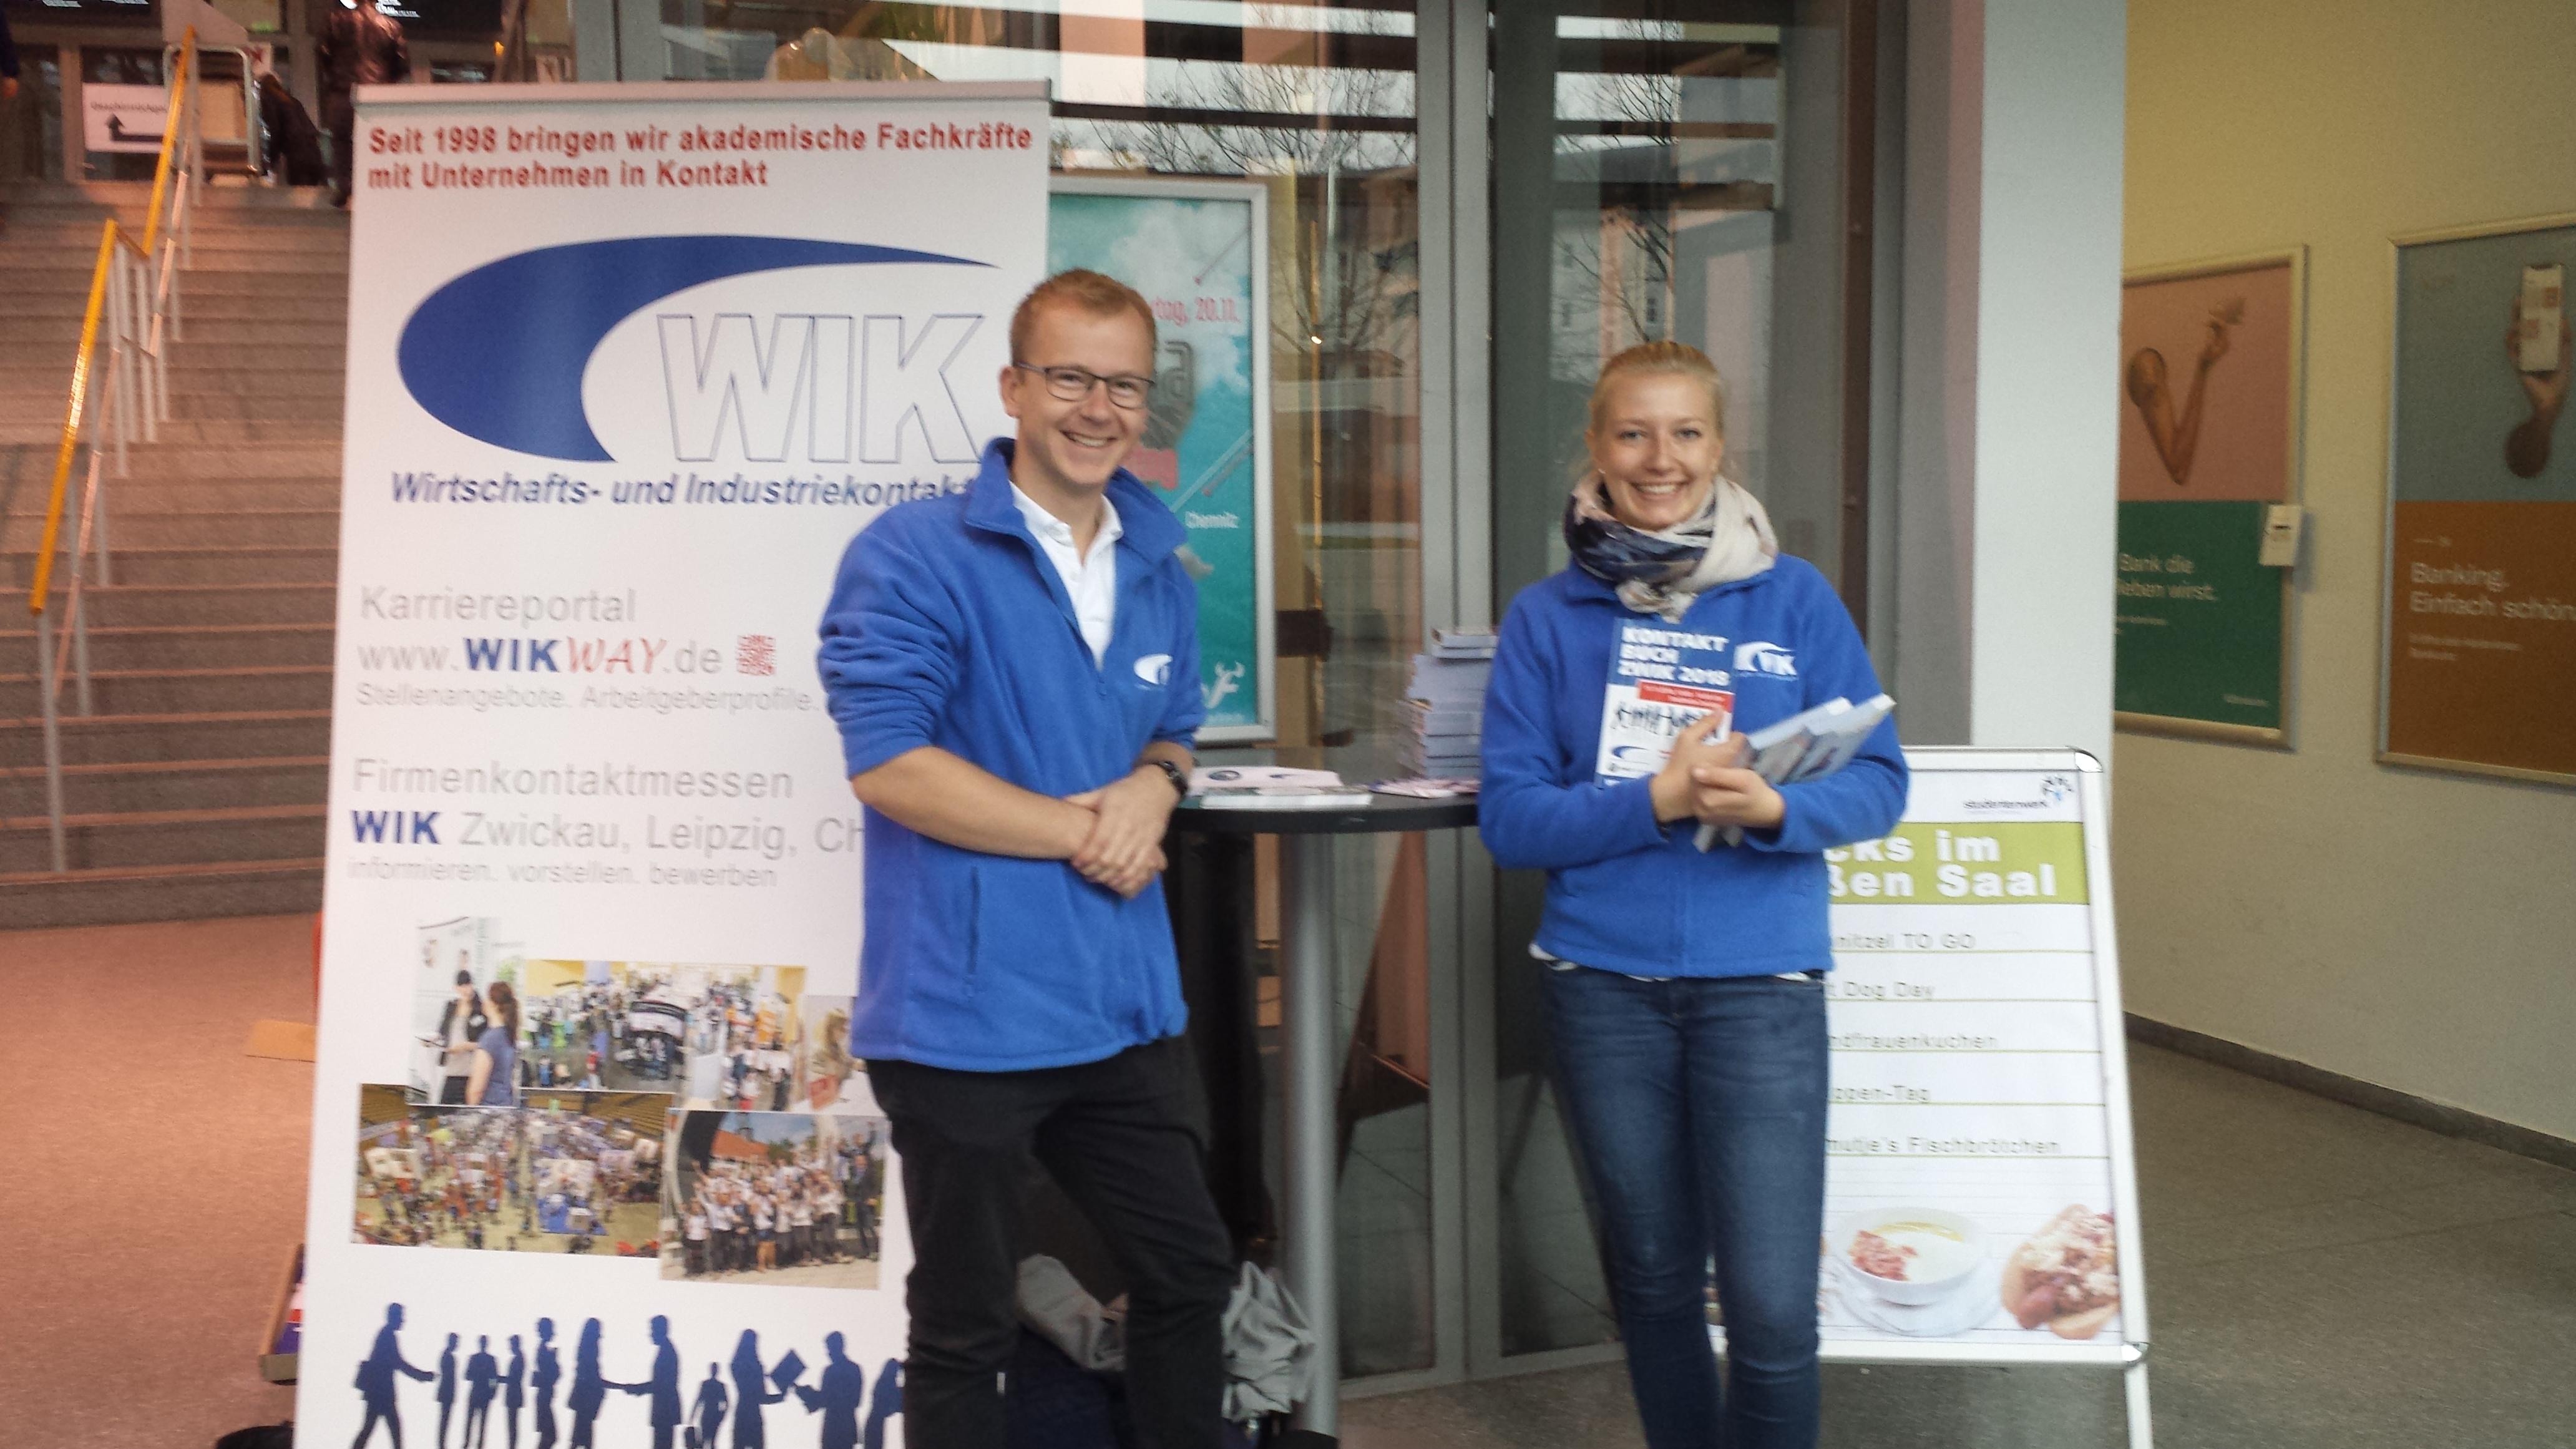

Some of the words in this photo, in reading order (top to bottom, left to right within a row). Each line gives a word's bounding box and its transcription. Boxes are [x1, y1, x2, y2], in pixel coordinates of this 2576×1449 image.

[369, 127, 424, 154] Seit
[437, 127, 496, 152] 1998
[507, 127, 617, 158] bringen
[625, 124, 670, 152] wir
[680, 123, 866, 152] akademische
[877, 122, 1033, 150] Fachkräfte
[368, 162, 412, 188] mit
[421, 161, 610, 187] Unternehmen
[620, 160, 645, 186] in
[656, 158, 768, 186] Kontakt
[657, 313, 985, 464] WIK
[392, 471, 602, 504] Wirtschafts-
[612, 472, 679, 503] und
[685, 472, 972, 505] Industriekontak
[361, 586, 635, 627] Karriereportal
[2409, 590, 2497, 617] Einfach
[358, 636, 723, 675] www.WIKWAY.de
[1620, 643, 1680, 664] BUCH
[1622, 626, 1730, 652] KONTAKT
[353, 759, 794, 799] Firmenkontaktmessen
[351, 811, 440, 844] WIK
[460, 812, 630, 852] Zwickau,
[1937, 830, 2001, 862] im
[1937, 864, 2056, 897] Saal
[1903, 934, 1933, 949] TO
[1940, 934, 1976, 949] GO
[1844, 982, 1886, 1000] Dog
